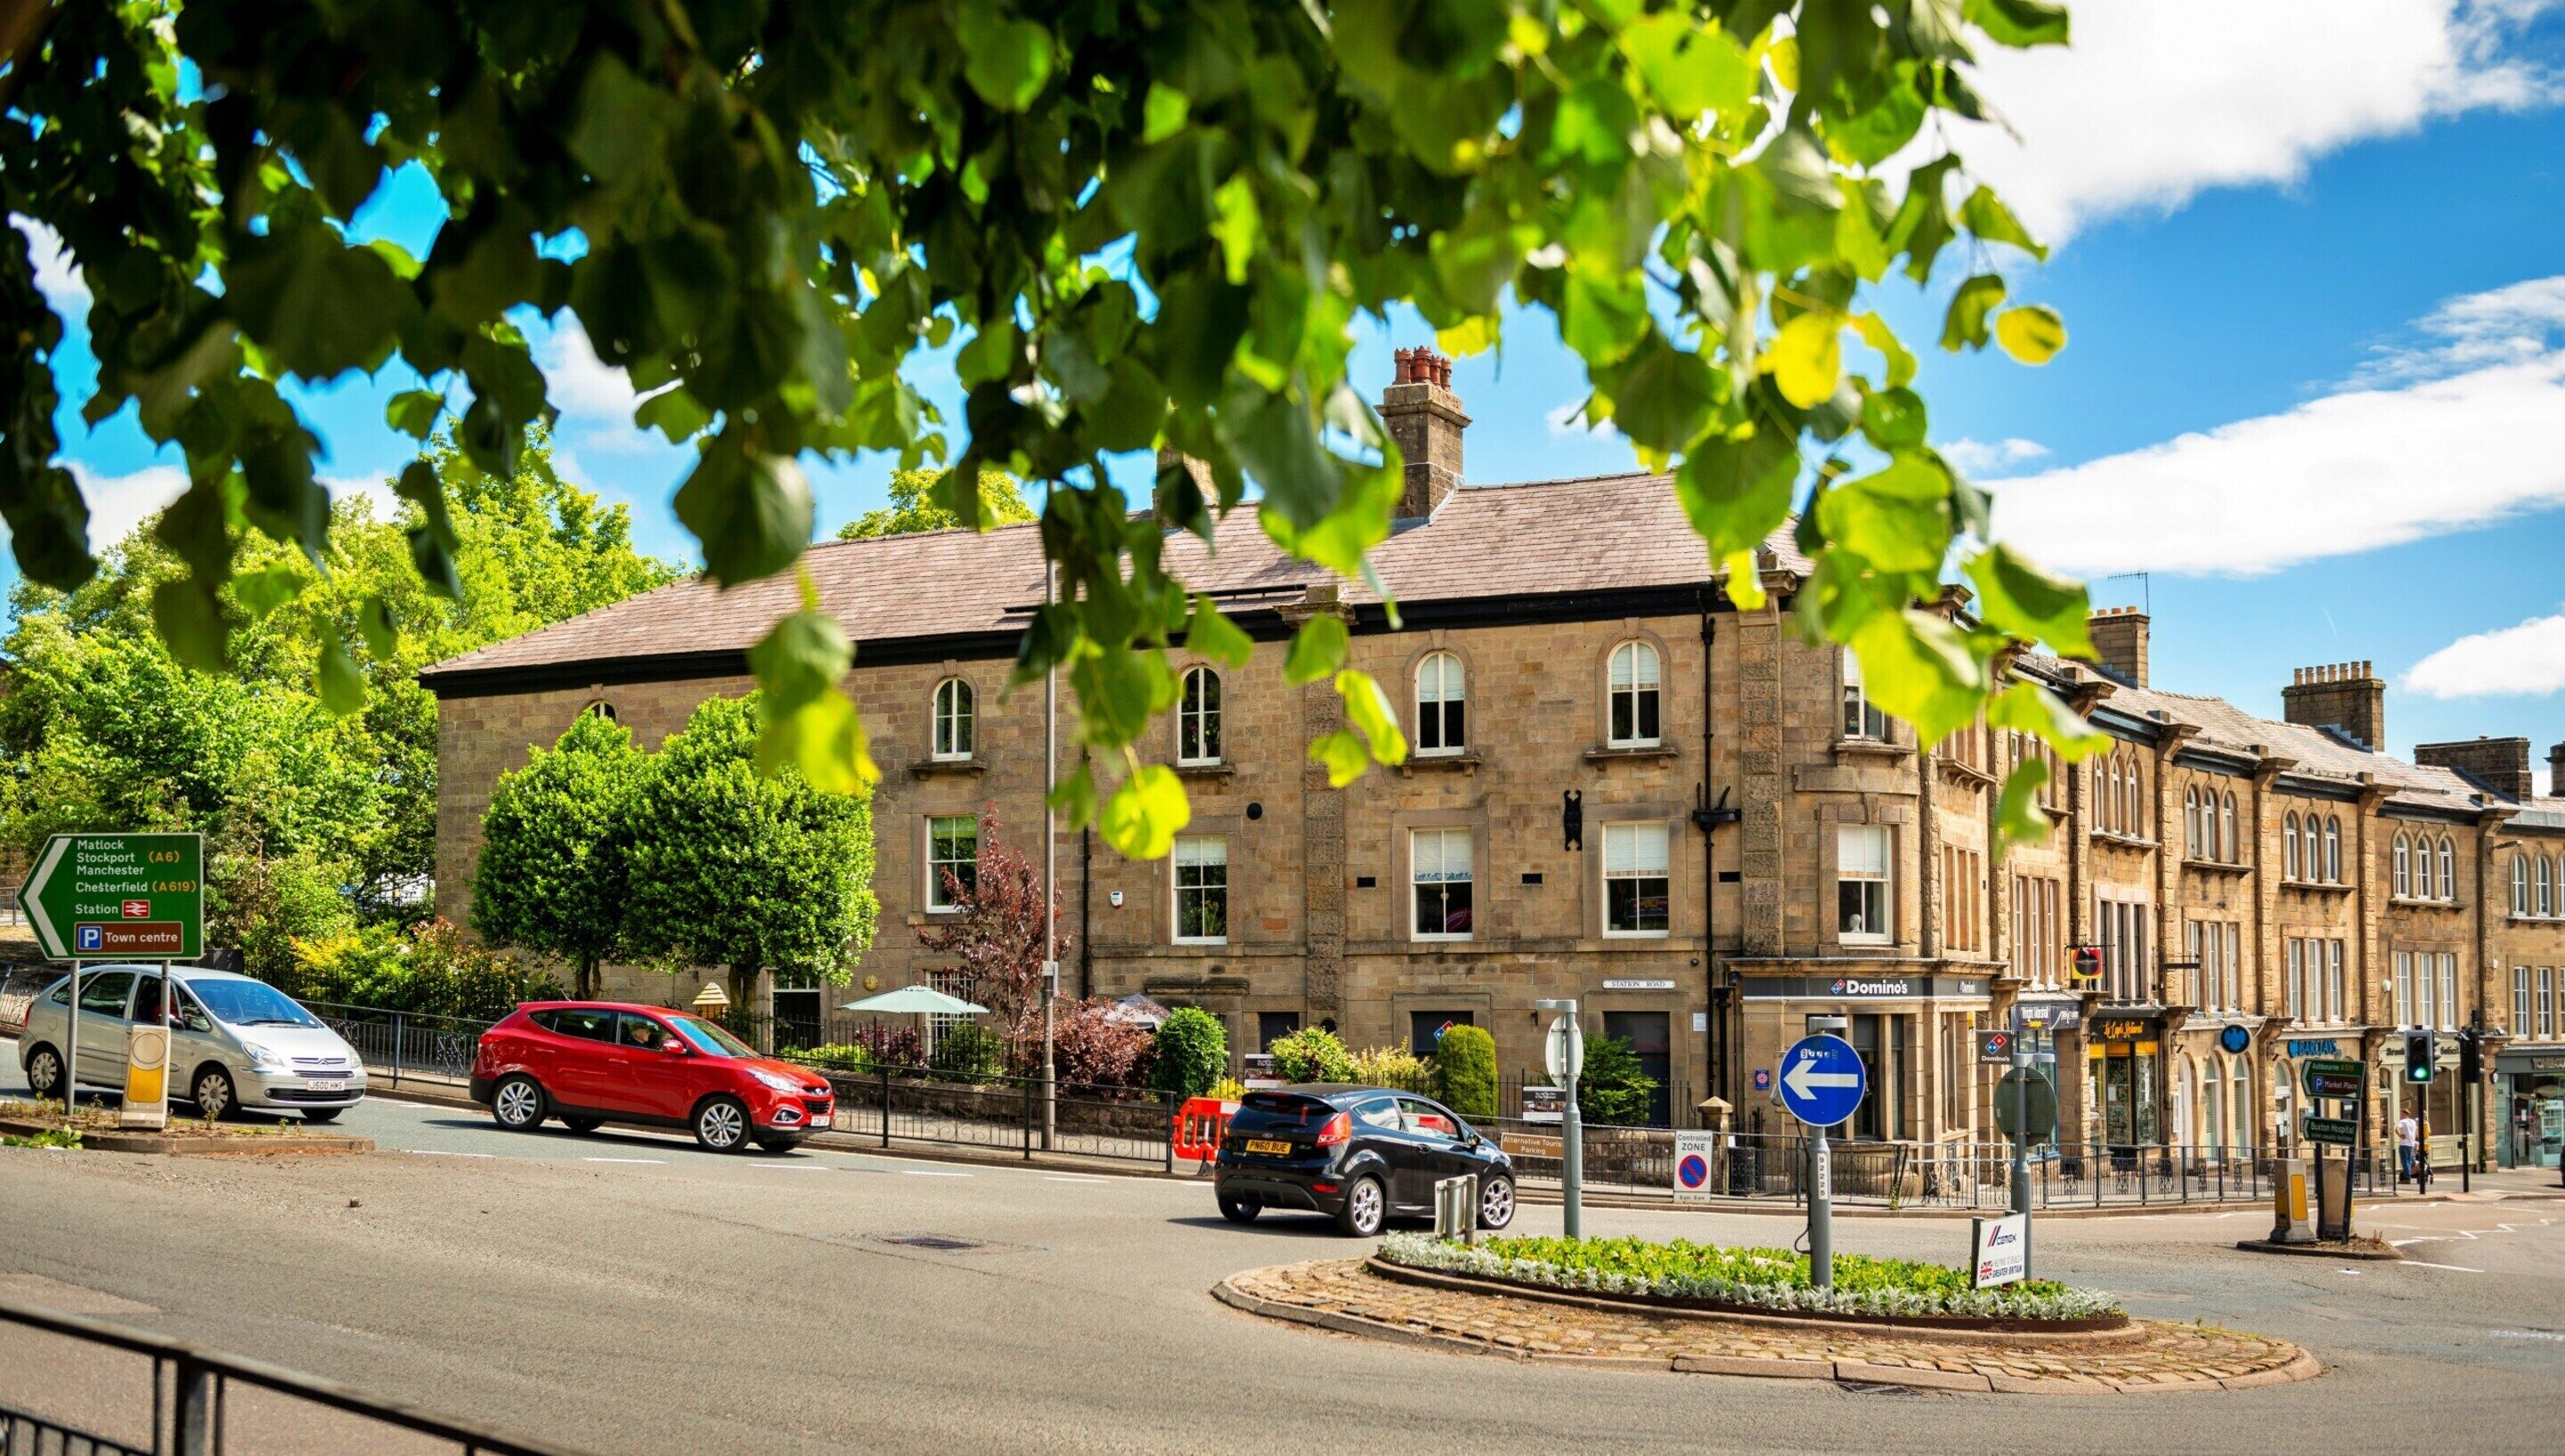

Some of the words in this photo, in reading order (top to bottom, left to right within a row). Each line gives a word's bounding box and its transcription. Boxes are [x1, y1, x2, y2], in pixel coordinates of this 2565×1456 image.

[77, 840, 125, 850] Matlock
[77, 852, 135, 864] Stockport
[77, 865, 144, 874] Manchester
[76, 882, 148, 892] Chesterfield
[75, 904, 118, 915] Station
[84, 929, 99, 948] P
[105, 932, 135, 942] Town
[140, 932, 178, 942] centre
[1846, 980, 1908, 994] Domino's
[2300, 1039, 2337, 1055] BARCLAYS
[2312, 1063, 2340, 1071] Ashbourne
[2325, 1081, 2342, 1089] Market
[2343, 1082, 2358, 1090] Place
[2310, 1123, 2330, 1131] Buxton
[2331, 1123, 2355, 1135] Hospital
[1503, 1136, 1541, 1145] Alternative
[1250, 1141, 1270, 1151] PN60
[1271, 1143, 1288, 1152] BUE
[1521, 1146, 1546, 1155] Parking
[1682, 1143, 1706, 1151] ZONE
